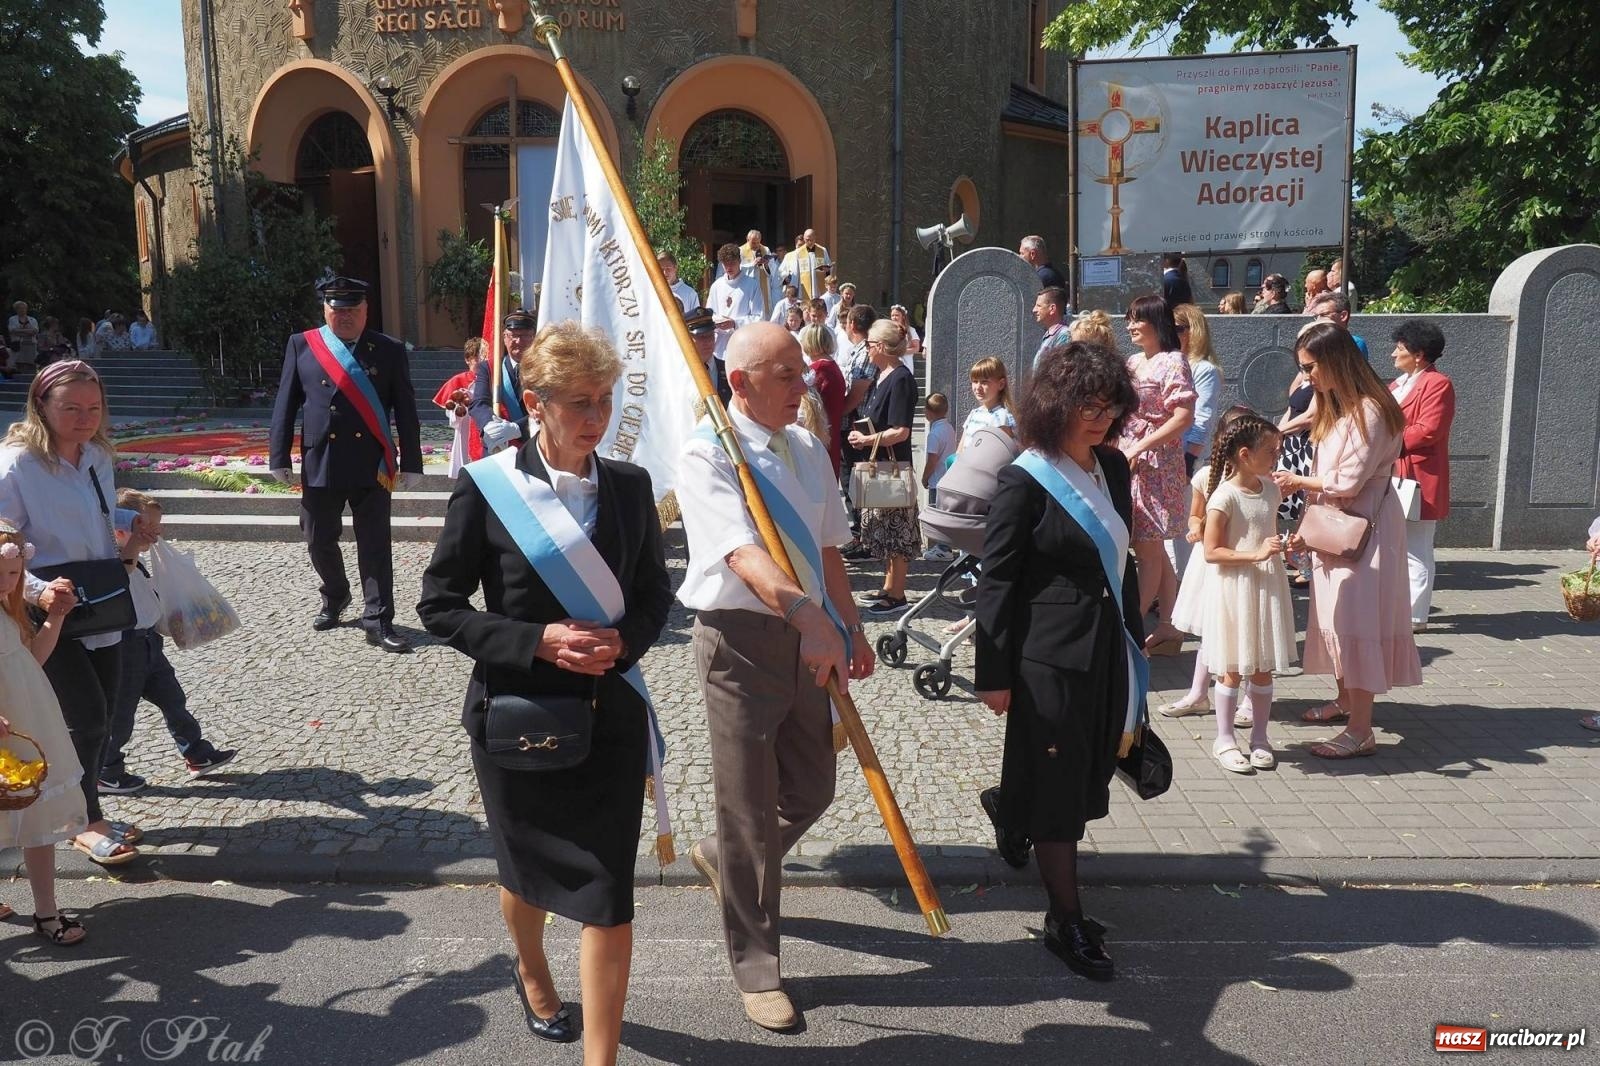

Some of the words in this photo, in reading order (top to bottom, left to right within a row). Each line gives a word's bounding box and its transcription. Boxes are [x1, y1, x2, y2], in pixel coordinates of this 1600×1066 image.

[375, 13, 417, 32] REGI
[1218, 68, 1230, 77] do
[1233, 65, 1260, 77] Filipa
[1197, 82, 1250, 95] pragniemy
[1253, 79, 1298, 92] zobaczyć
[1205, 113, 1300, 144] Kaplica
[1180, 143, 1323, 175] Wieczystej
[1197, 177, 1304, 208] Adoracji
[1161, 232, 1197, 243] wejście
[1199, 232, 1211, 241] od
[1214, 231, 1248, 243] prawej
[1250, 228, 1281, 240] strony
[1284, 226, 1324, 238] kościoła
[626, 371, 648, 396] DO
